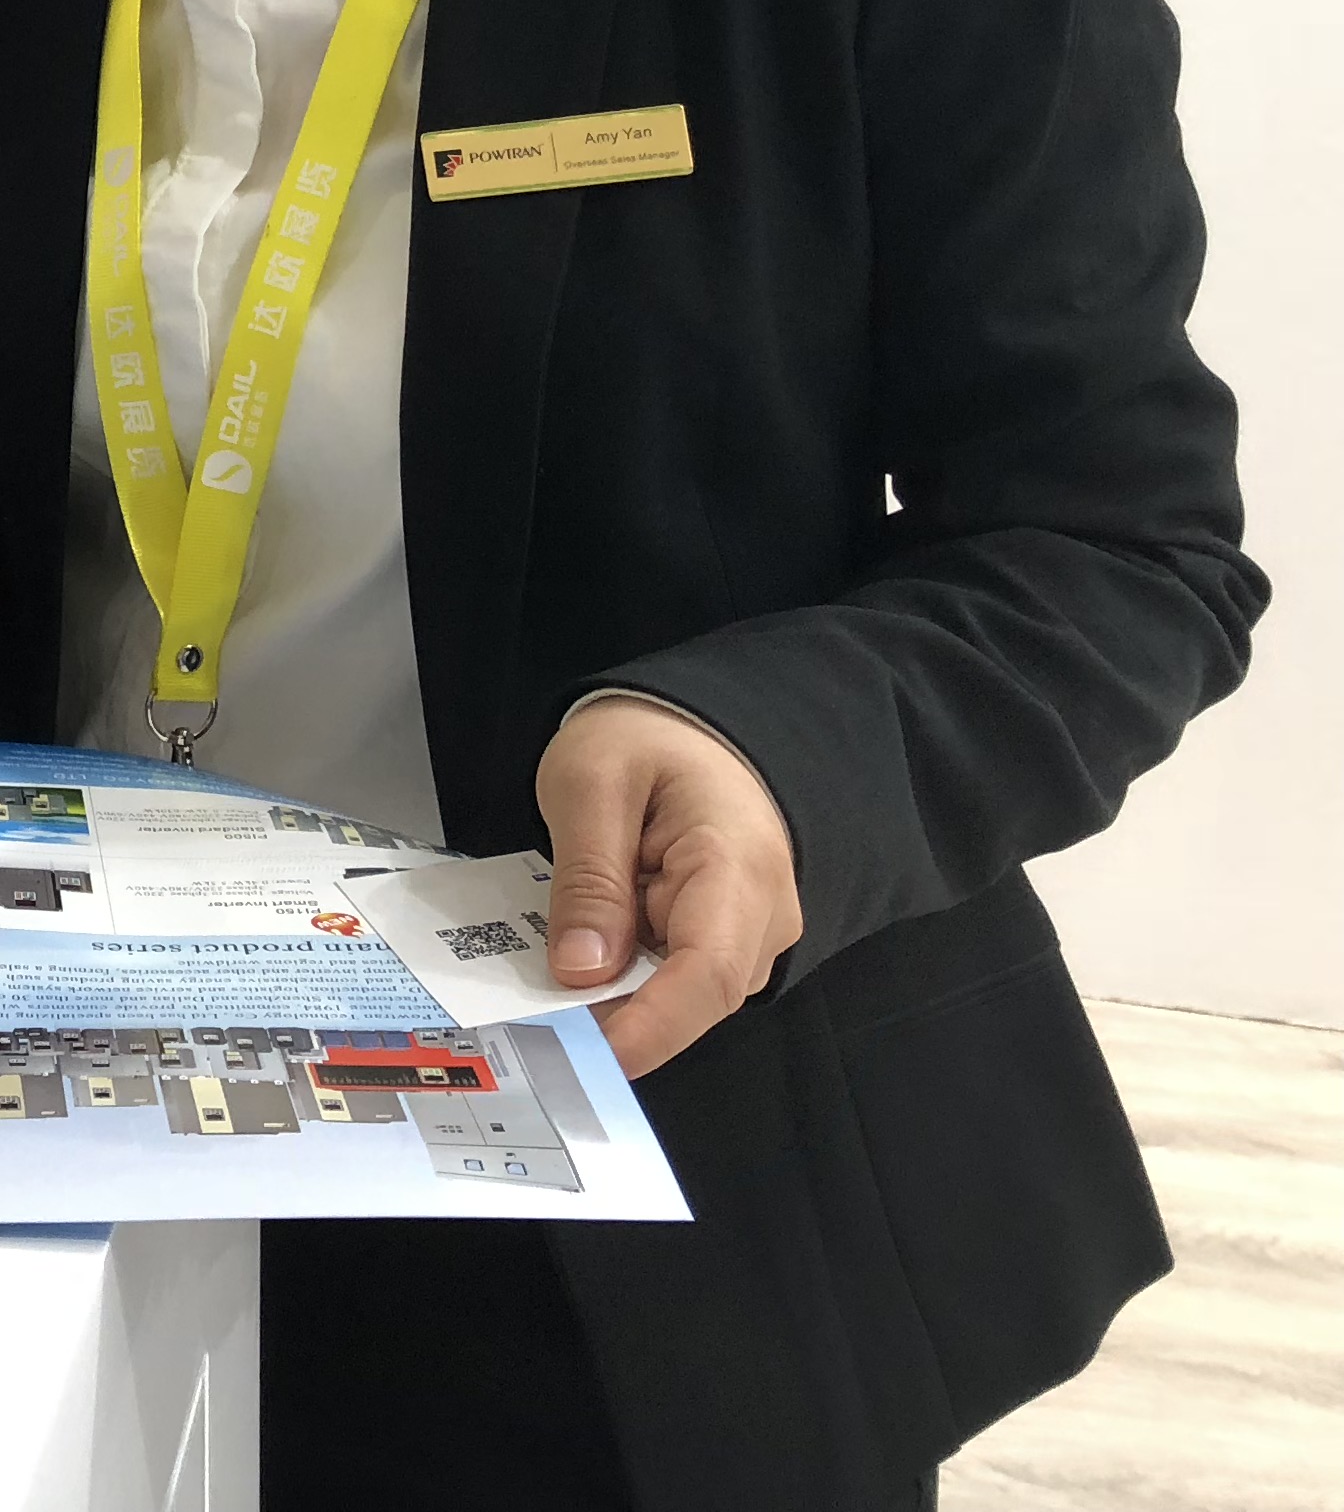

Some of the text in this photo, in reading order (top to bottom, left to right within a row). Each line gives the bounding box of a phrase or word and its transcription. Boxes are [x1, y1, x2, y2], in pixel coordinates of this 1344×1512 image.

[604, 127, 674, 146] Amy Yan
[469, 145, 555, 165] POWTRAN
[247, 156, 338, 338] 达欧展览
[217, 357, 258, 444] DAIL
[316, 914, 354, 929] NEW
[91, 938, 314, 955] product series
[47, 964, 109, 975] forming
[6, 974, 40, 982] such
[47, 974, 115, 984] products
[120, 975, 172, 985] saving
[238, 975, 358, 984] comprehensive
[67, 986, 130, 994] network
[135, 986, 192, 994] service
[231, 985, 298, 993] logistics
[151, 995, 204, 1003] Dalian
